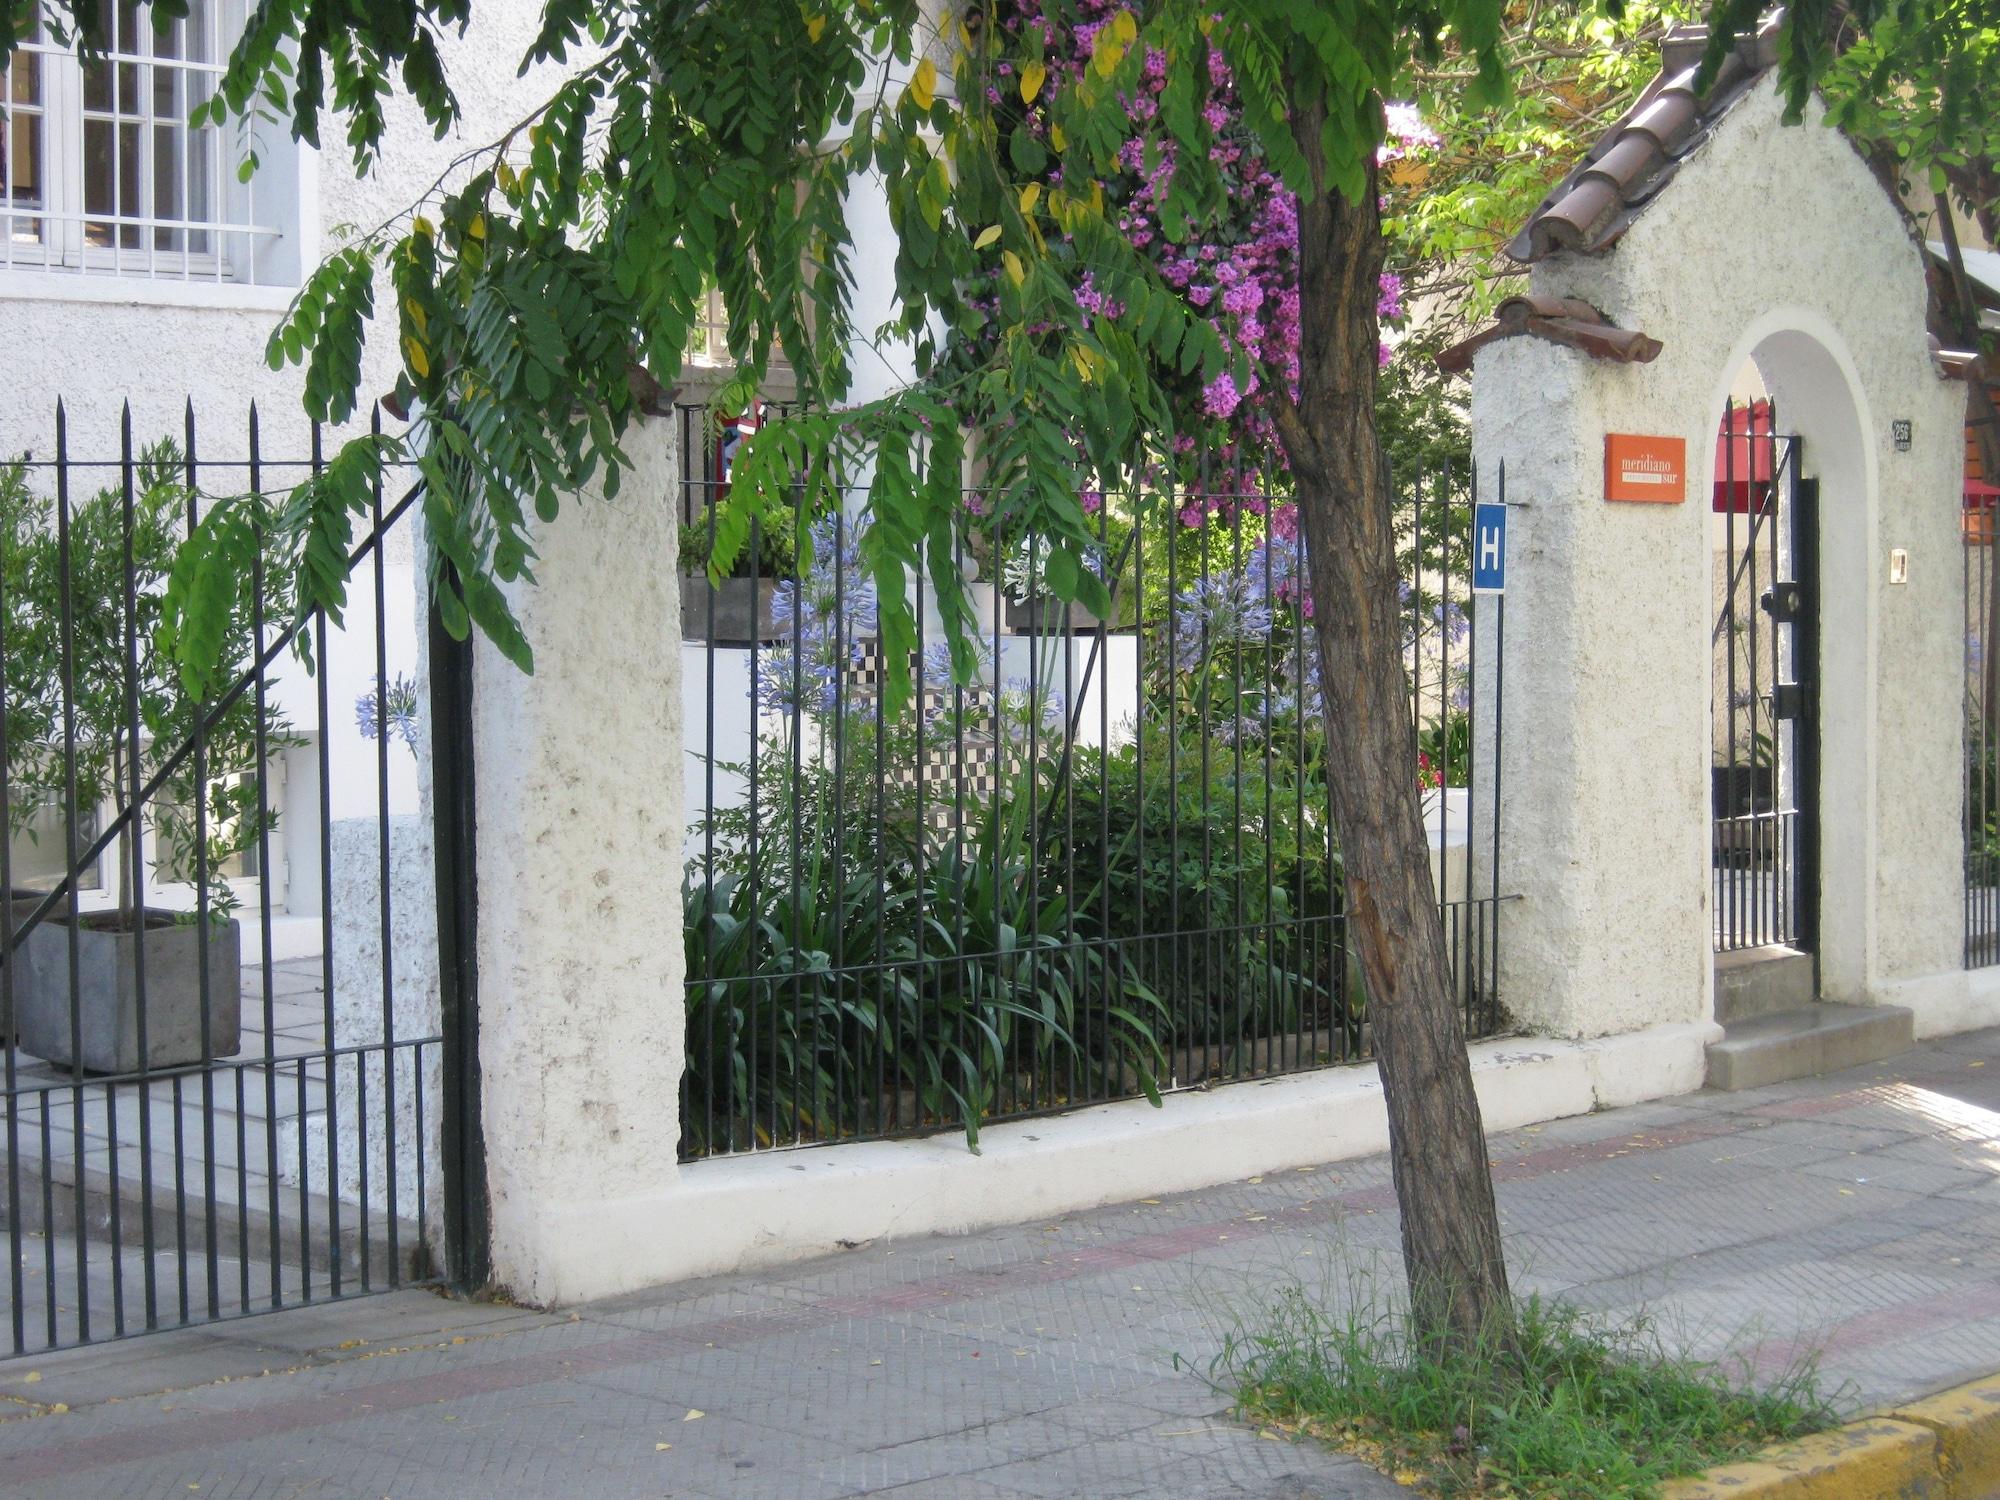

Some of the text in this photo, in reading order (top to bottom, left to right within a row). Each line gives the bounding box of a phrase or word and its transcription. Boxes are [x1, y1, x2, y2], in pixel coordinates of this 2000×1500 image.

[1621, 454, 1671, 472] meridiano
[1662, 473, 1678, 485] sur
[1481, 526, 1499, 570] H
